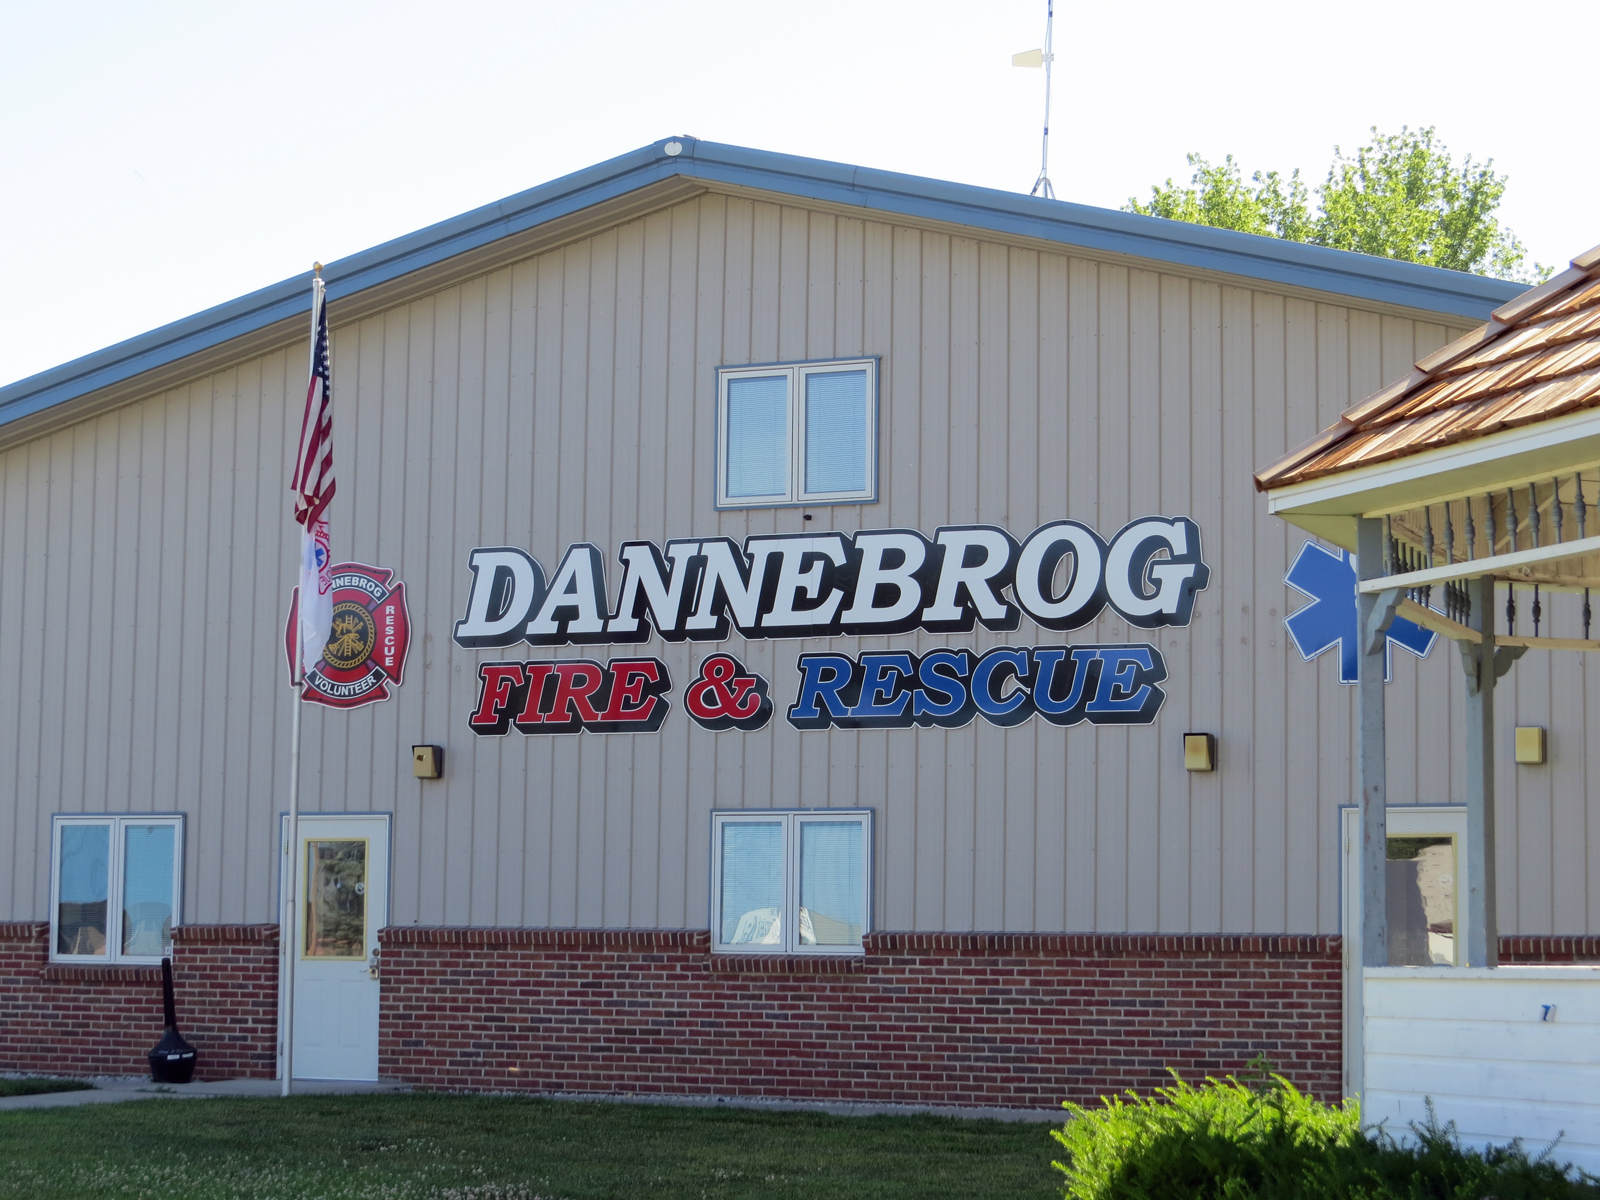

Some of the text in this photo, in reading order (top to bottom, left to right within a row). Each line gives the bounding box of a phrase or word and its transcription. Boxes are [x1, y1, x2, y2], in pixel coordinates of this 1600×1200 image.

[456, 520, 1198, 639] DANNEBROG
[384, 605, 395, 667] RESCUE
[313, 675, 377, 696] VOLUNTEER
[471, 647, 1156, 725] FIRE & RESCUE
